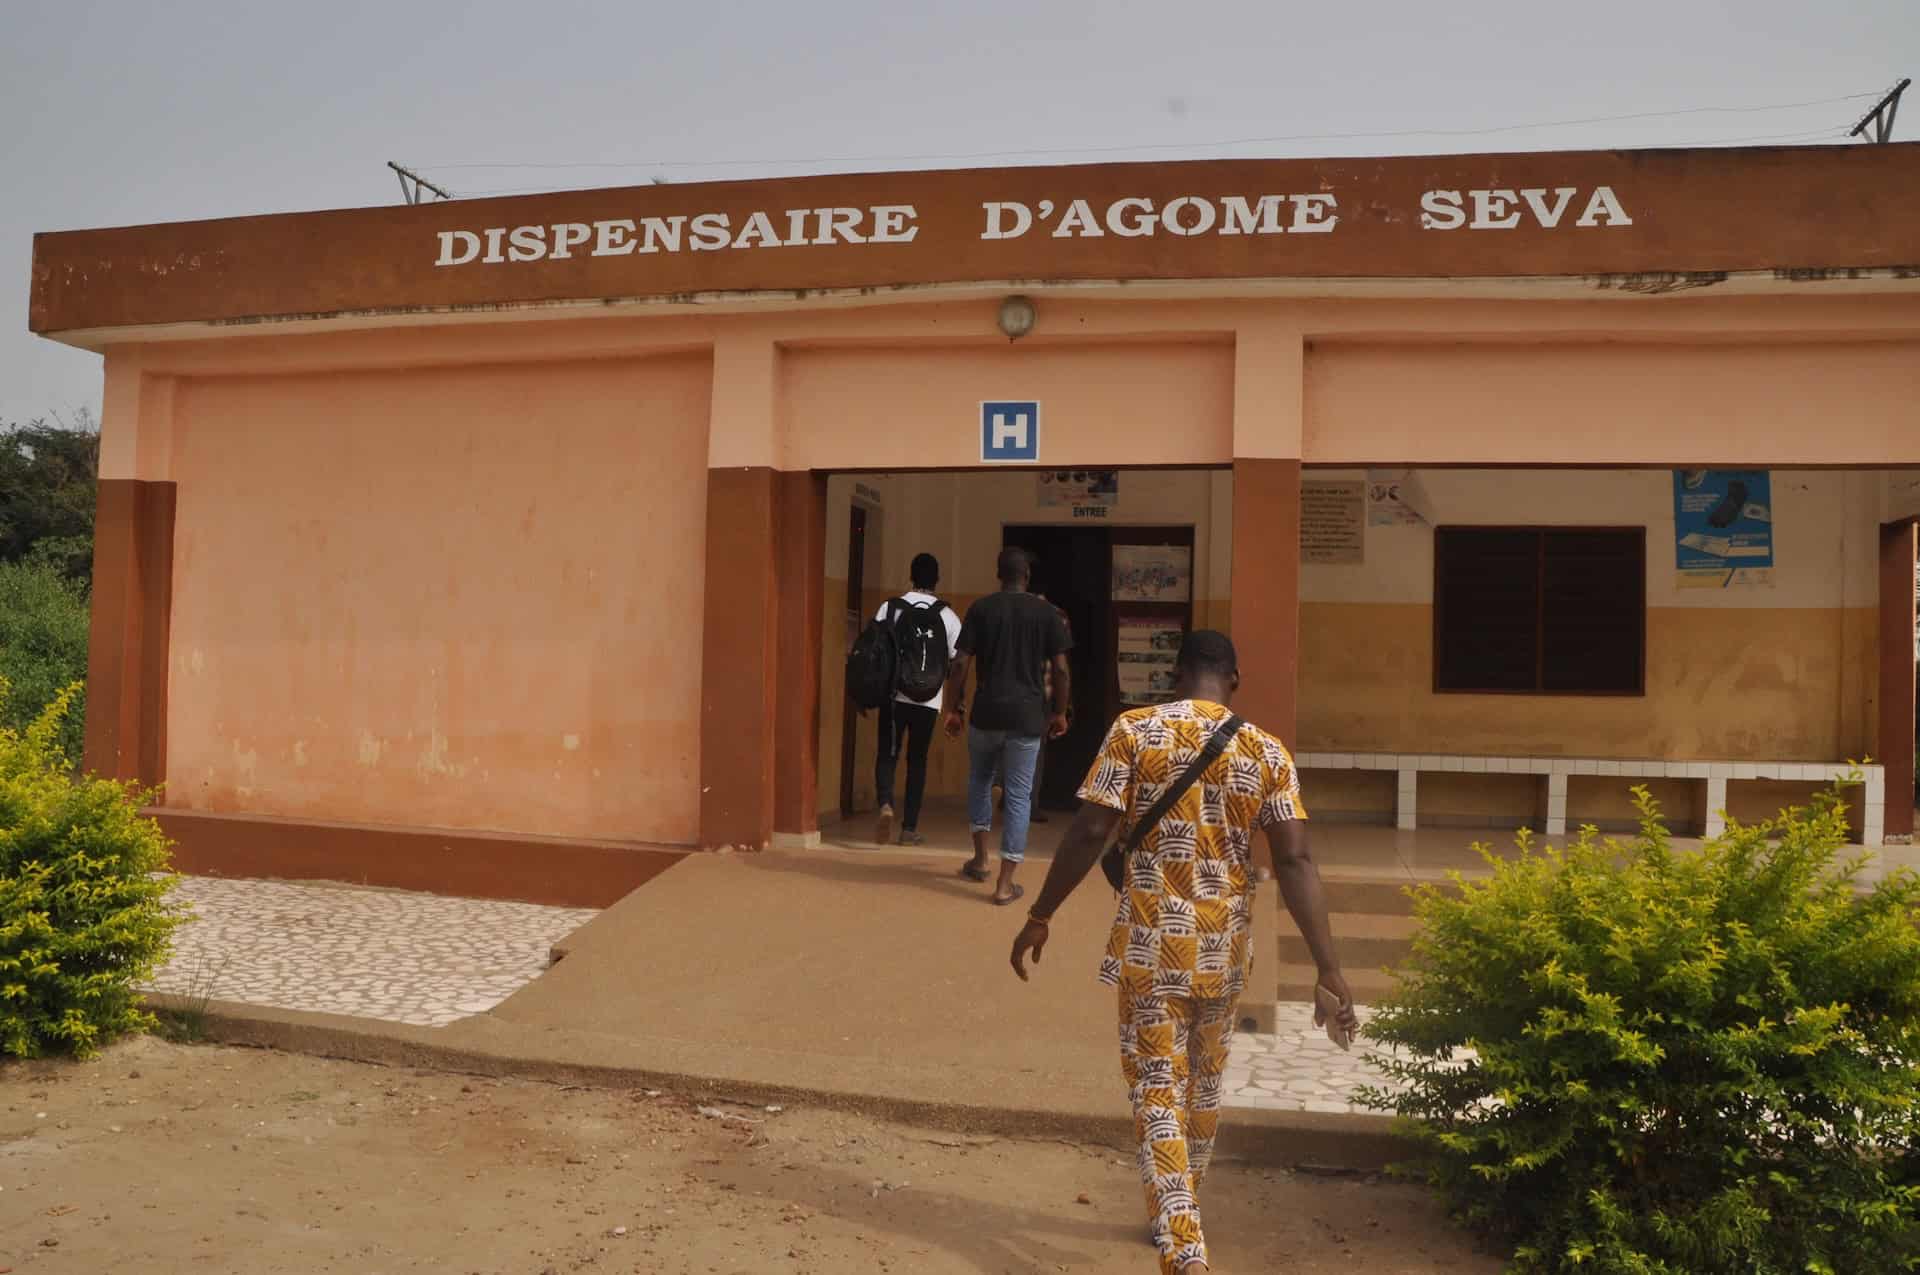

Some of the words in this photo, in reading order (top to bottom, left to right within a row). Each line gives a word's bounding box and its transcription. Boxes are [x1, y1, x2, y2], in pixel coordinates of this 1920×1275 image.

[435, 205, 919, 266] DISPENSAIRE
[981, 195, 1339, 240] D'AGOME
[1420, 187, 1633, 230] SEVA
[992, 414, 1028, 449] H
